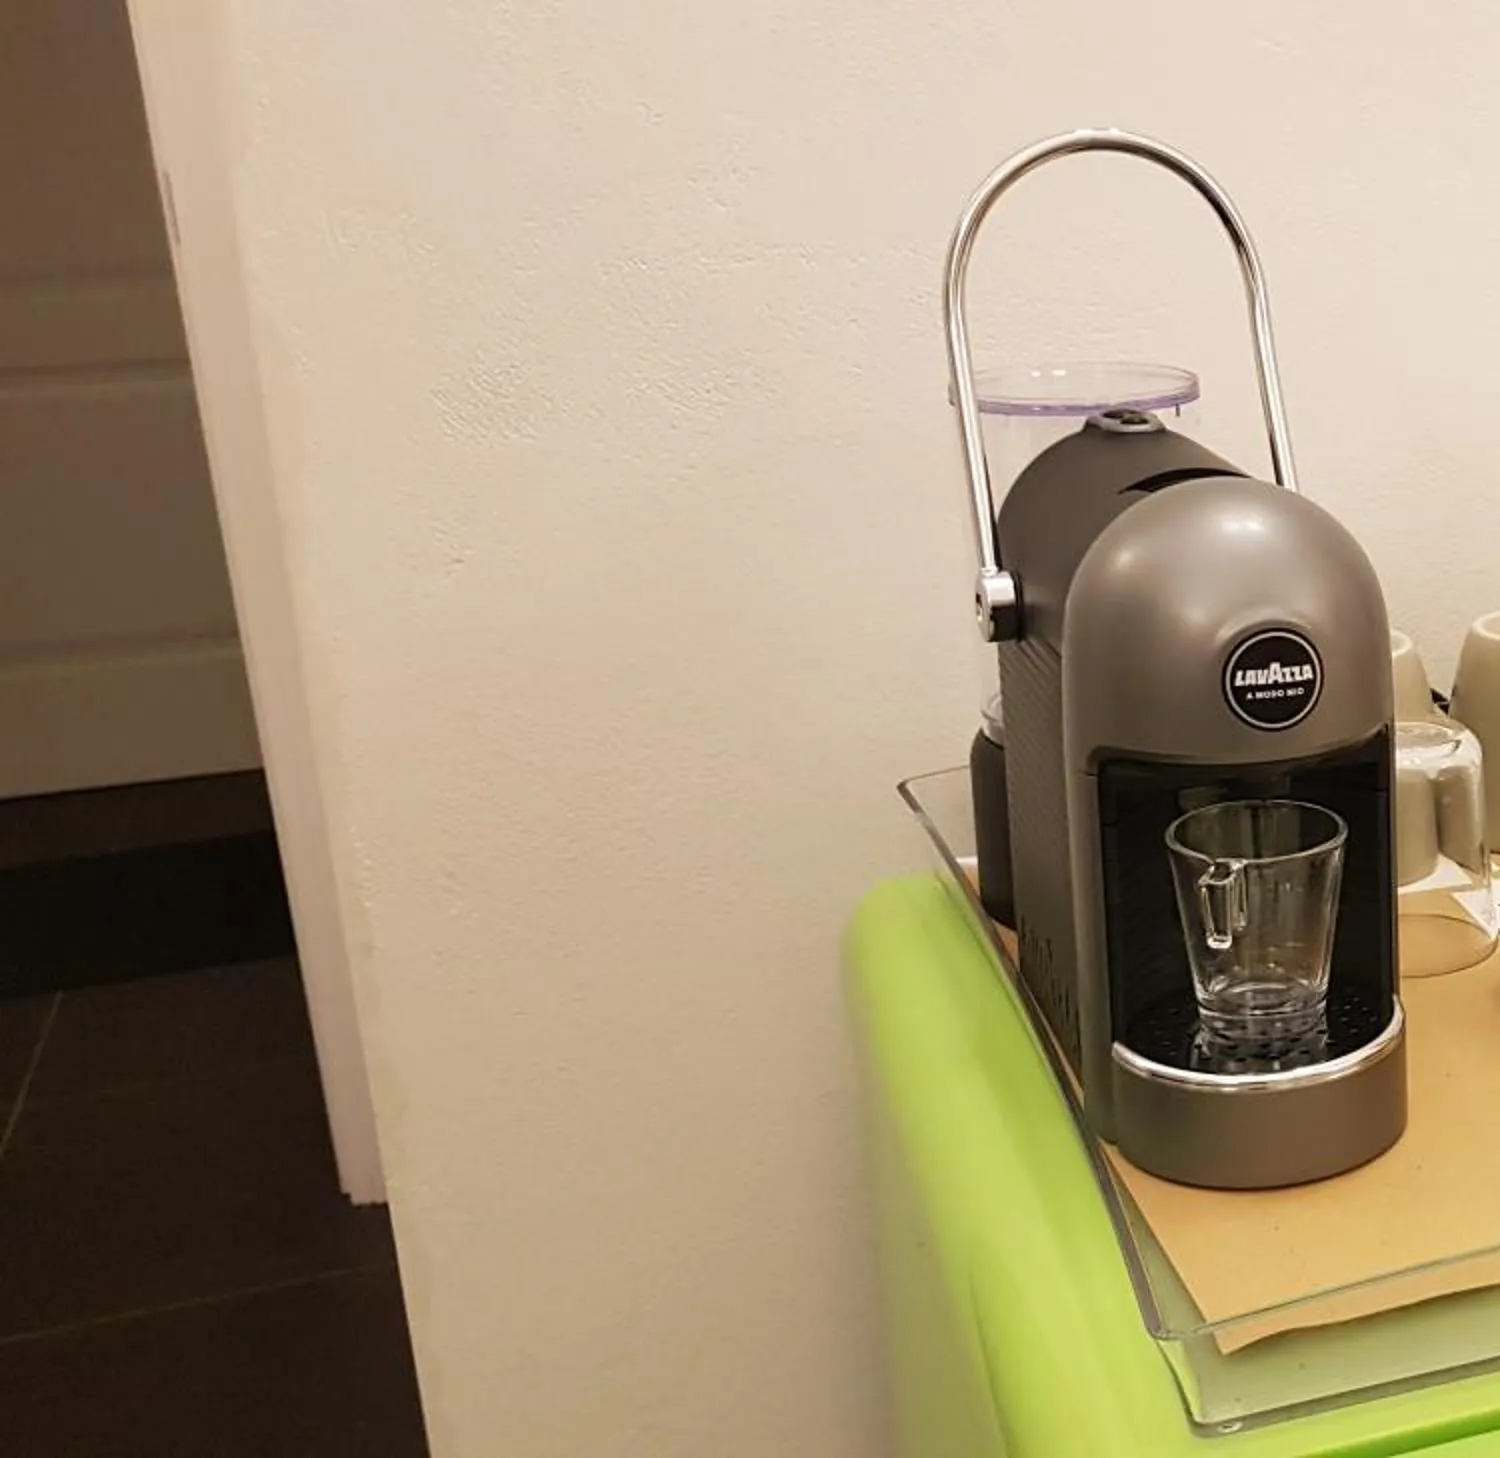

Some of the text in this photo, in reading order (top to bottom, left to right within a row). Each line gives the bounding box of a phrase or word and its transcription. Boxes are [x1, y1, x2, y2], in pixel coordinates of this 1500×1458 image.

[1234, 662, 1314, 687] LAVAZZA
[1246, 686, 1305, 700] A MODO MIO
